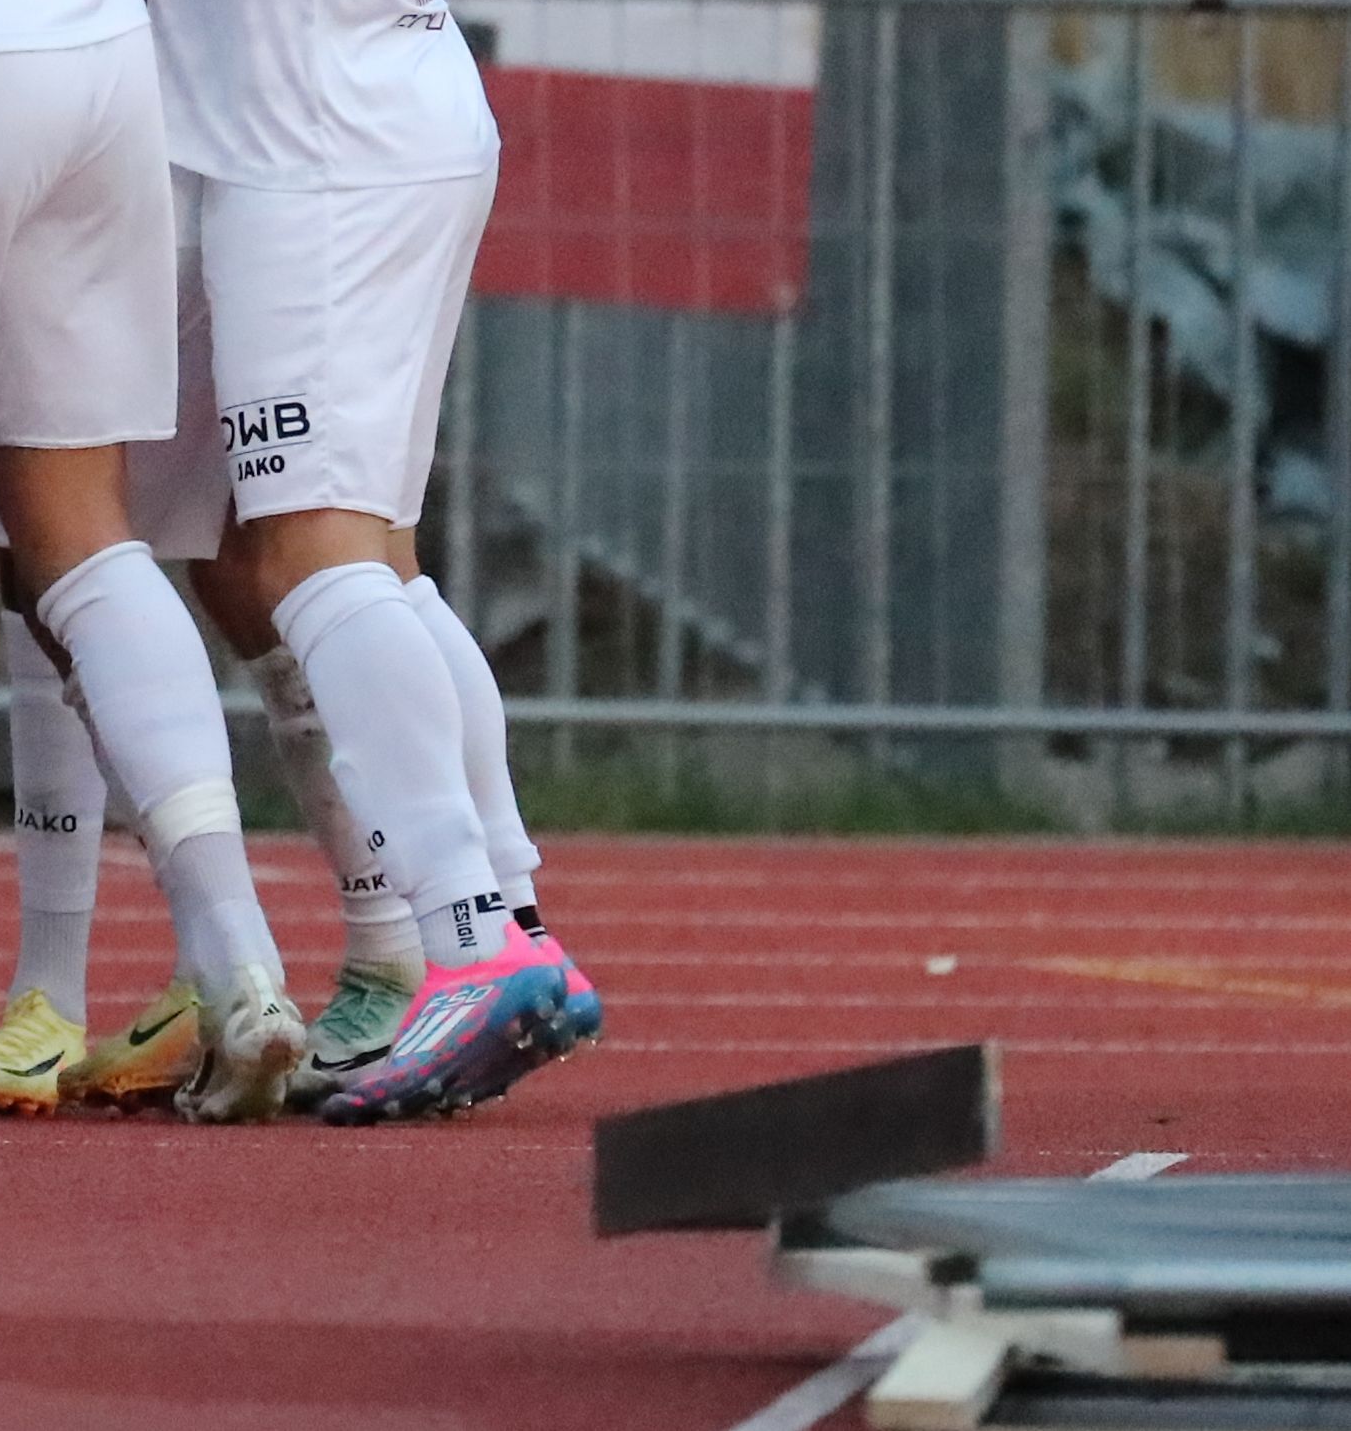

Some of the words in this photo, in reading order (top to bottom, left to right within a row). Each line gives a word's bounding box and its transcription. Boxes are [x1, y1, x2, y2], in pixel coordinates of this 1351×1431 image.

[238, 454, 285, 482] JAKO
[18, 808, 77, 832] JAKO
[341, 872, 387, 893] JAK
[452, 899, 478, 949] ESIGN
